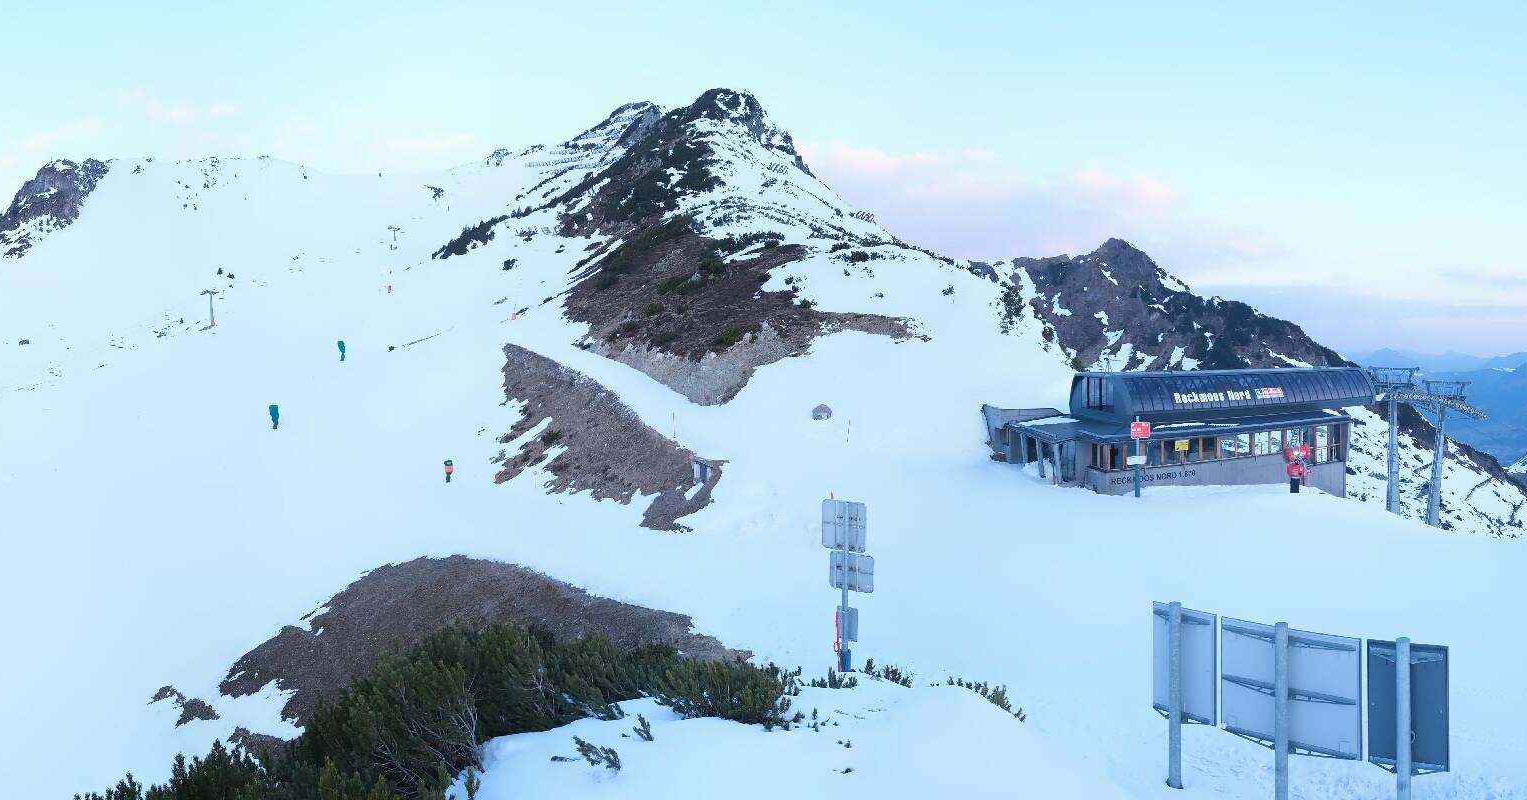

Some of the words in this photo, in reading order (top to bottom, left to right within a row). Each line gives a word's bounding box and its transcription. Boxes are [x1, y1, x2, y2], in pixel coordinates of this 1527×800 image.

[1174, 391, 1225, 404] Reckmoos
[1227, 389, 1252, 401] Nord
[1111, 474, 1154, 485] RECKOOS
[1156, 471, 1177, 481] NORD
